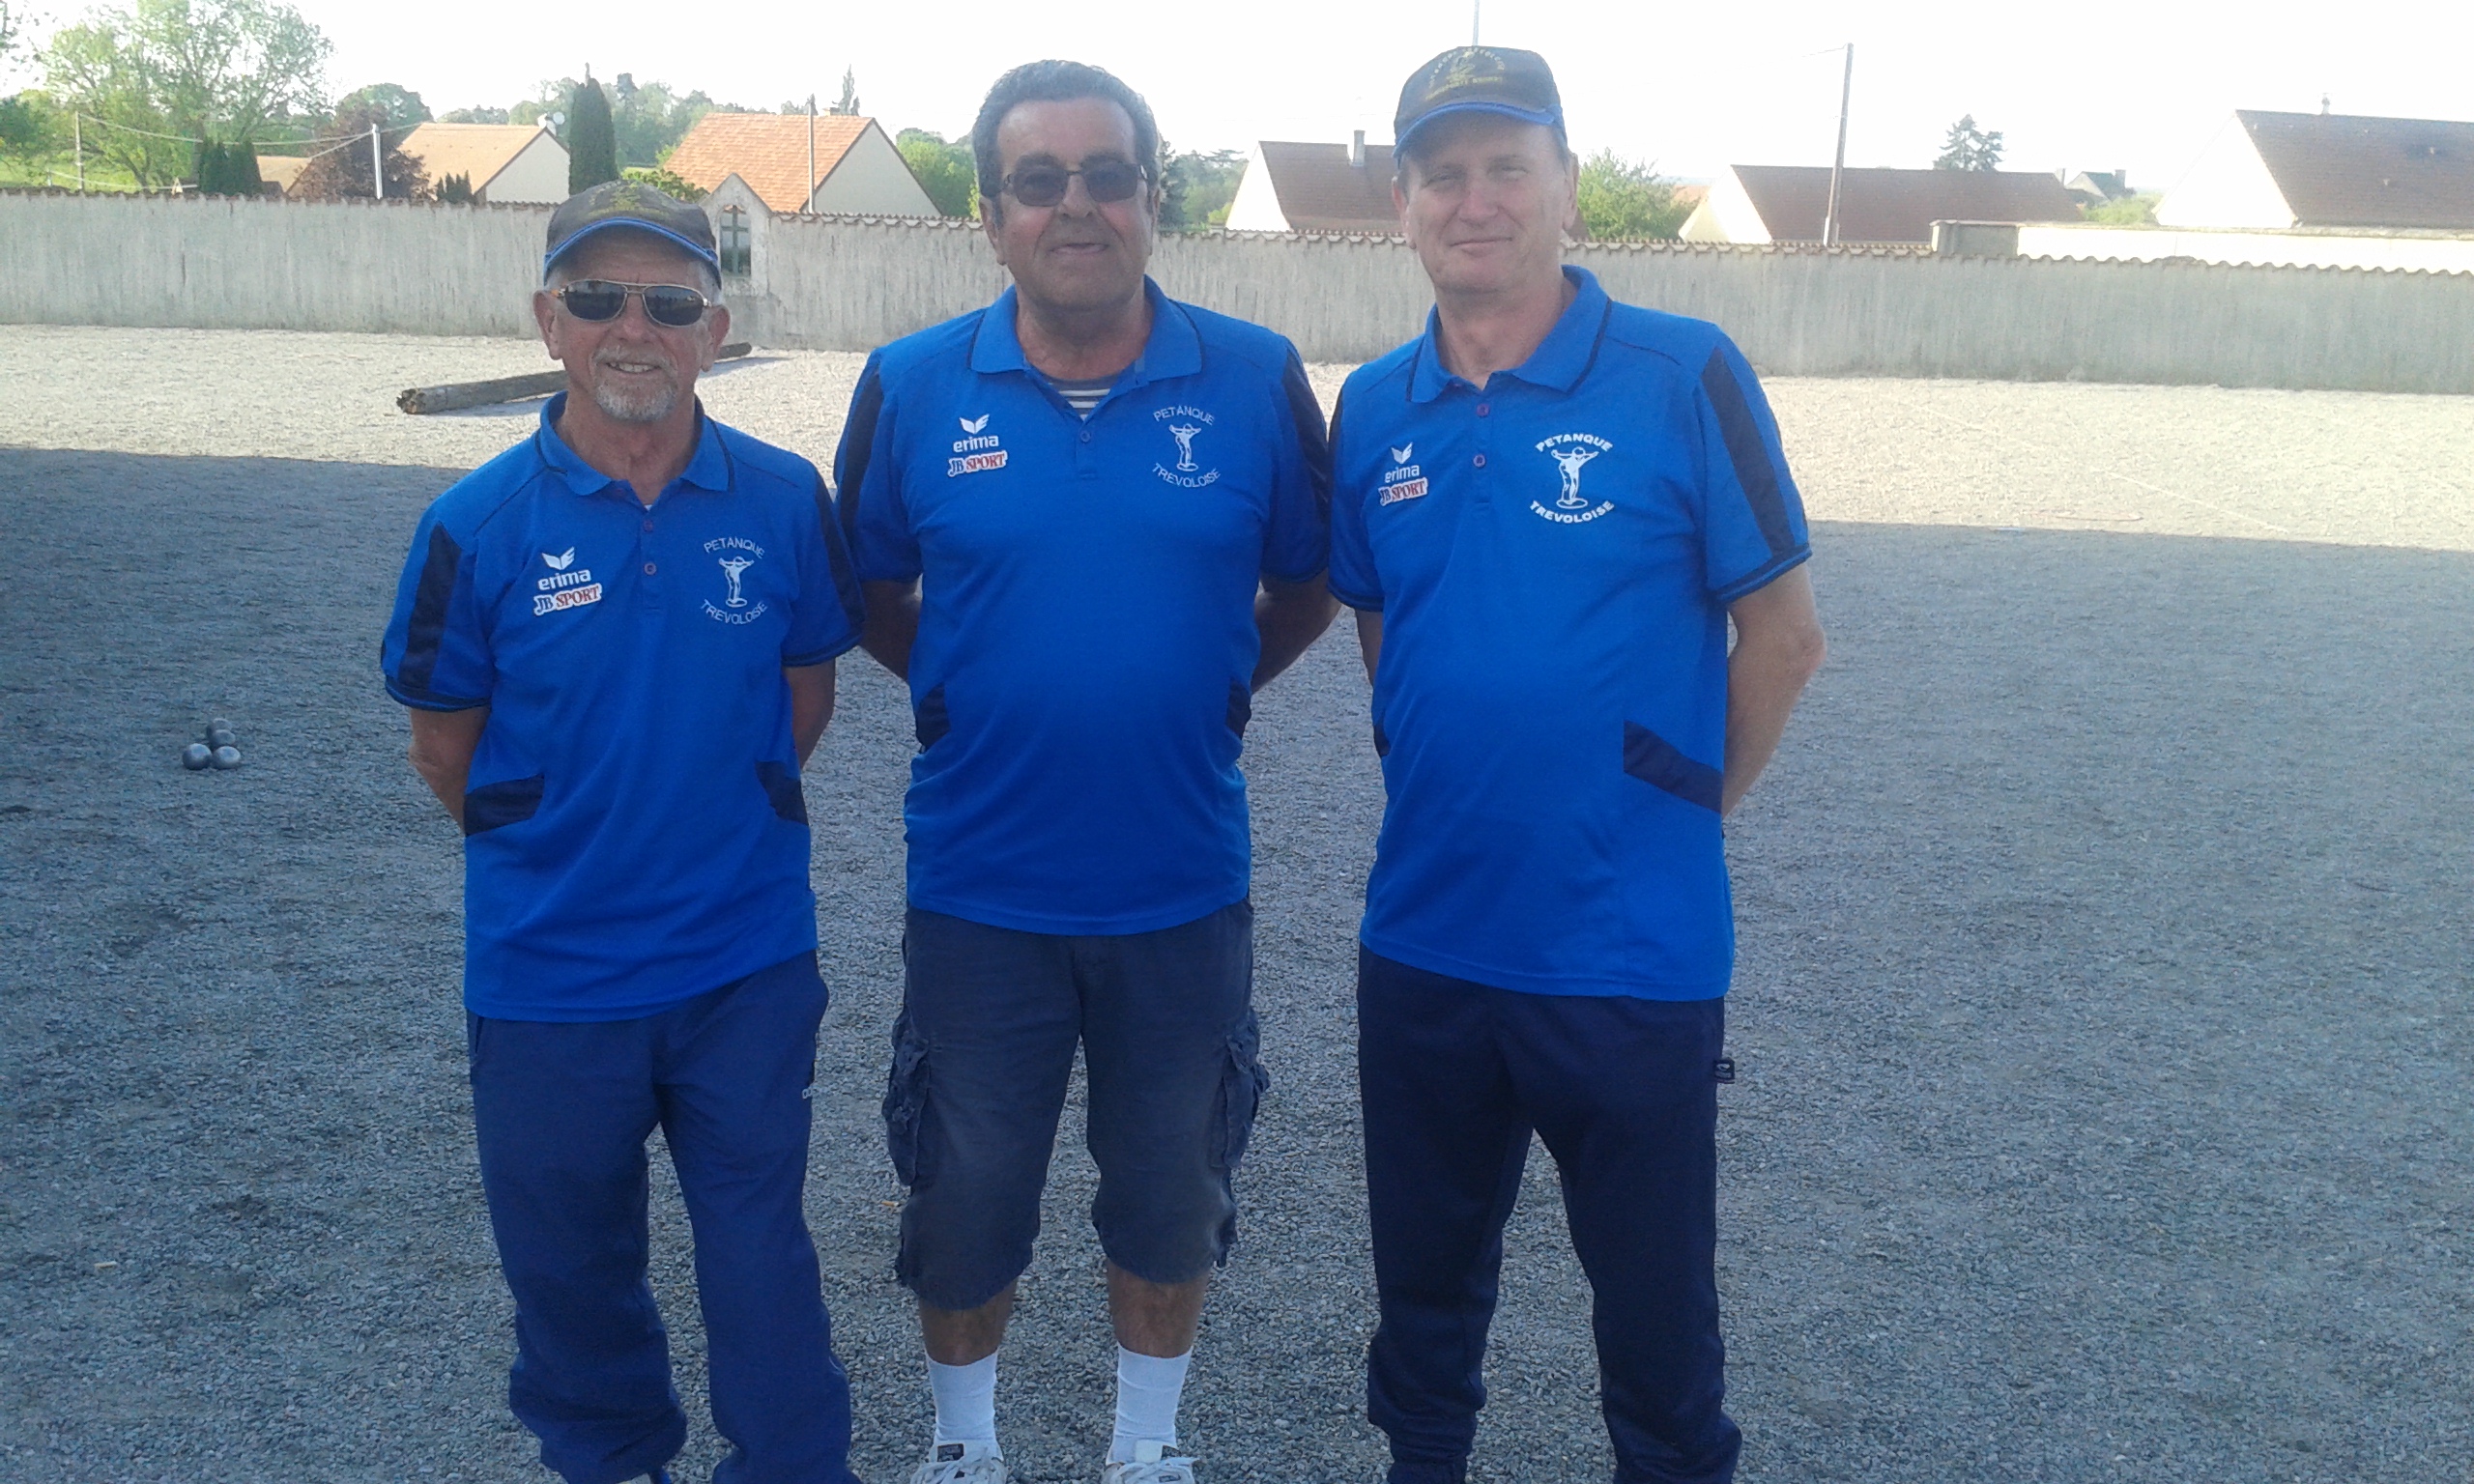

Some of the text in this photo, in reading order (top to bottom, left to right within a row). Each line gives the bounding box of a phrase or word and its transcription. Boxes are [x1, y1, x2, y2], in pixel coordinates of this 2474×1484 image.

[1153, 405, 1215, 426] PETANQUE
[953, 435, 999, 453] erima
[1535, 433, 1614, 453] PETANQUE
[949, 453, 1005, 475] JB SPORT
[1384, 464, 1421, 483] erima
[1379, 480, 1425, 504] JB SPORT
[1529, 499, 1615, 524] TREVOLOISE
[703, 536, 765, 559] PETANQUE
[537, 569, 591, 591] erima
[534, 585, 600, 614] JB SPORT
